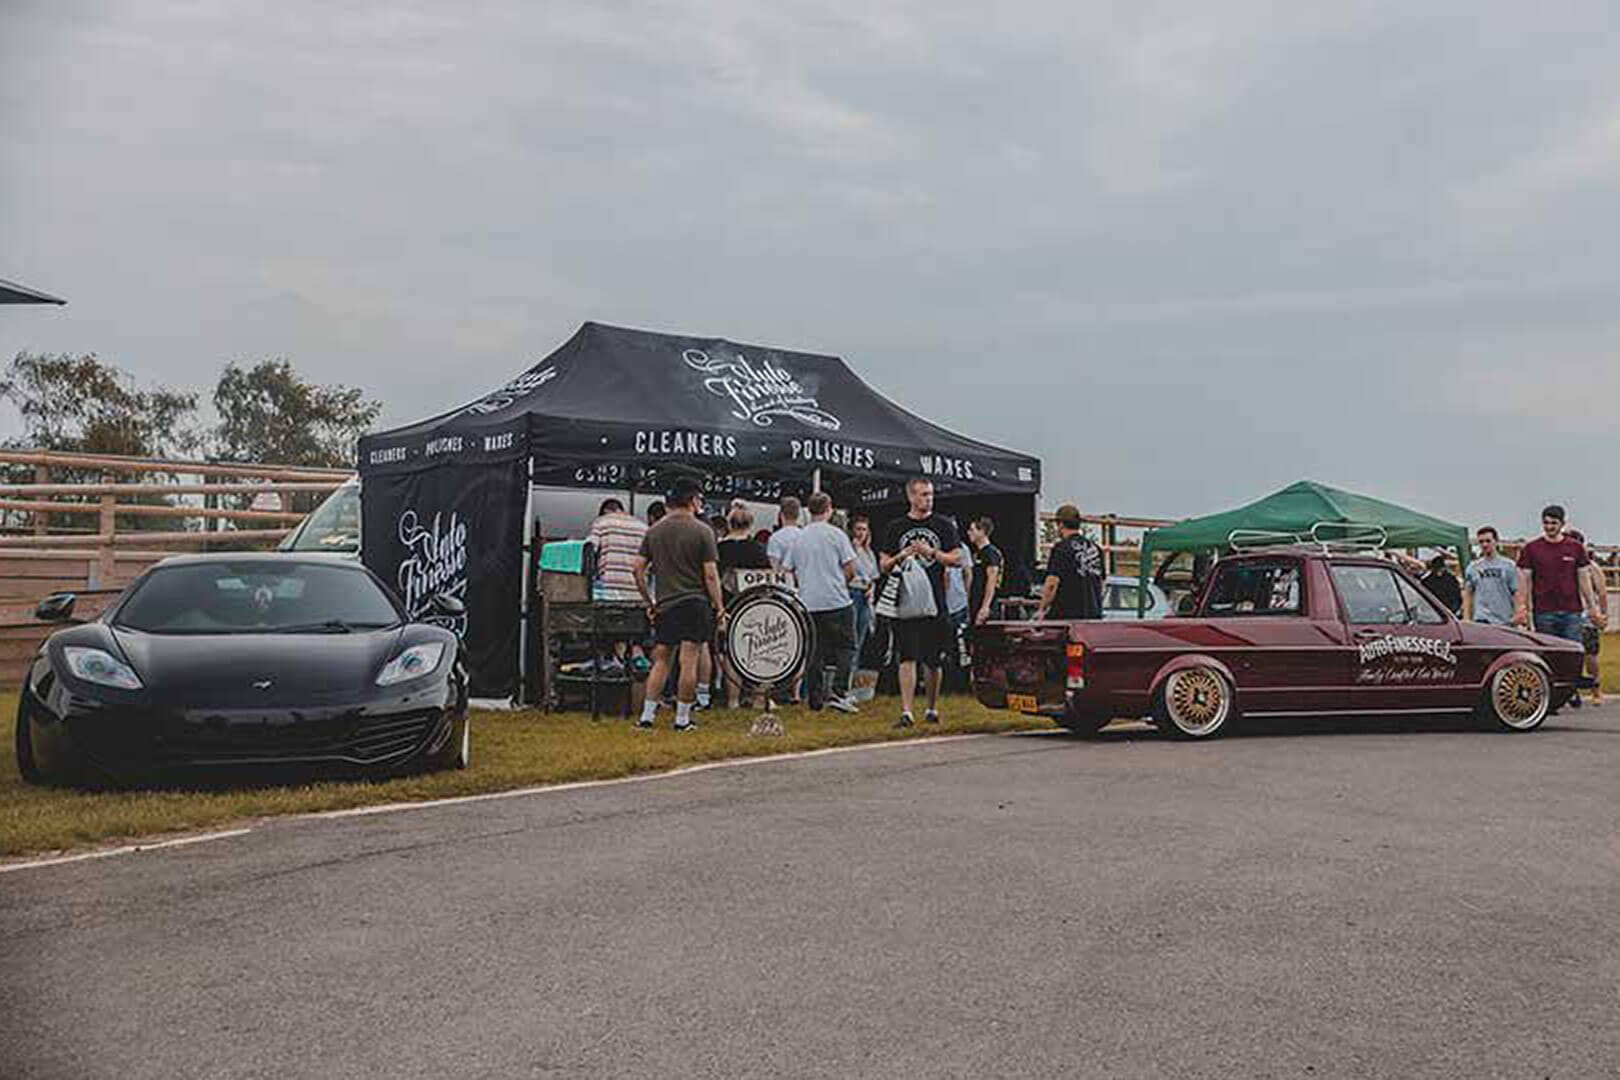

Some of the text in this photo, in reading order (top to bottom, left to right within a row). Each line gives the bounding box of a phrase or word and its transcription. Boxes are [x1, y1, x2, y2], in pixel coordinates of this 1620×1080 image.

[634, 430, 975, 480] CLEANERS POLISHES WAXES
[744, 572, 787, 585] OPEN
